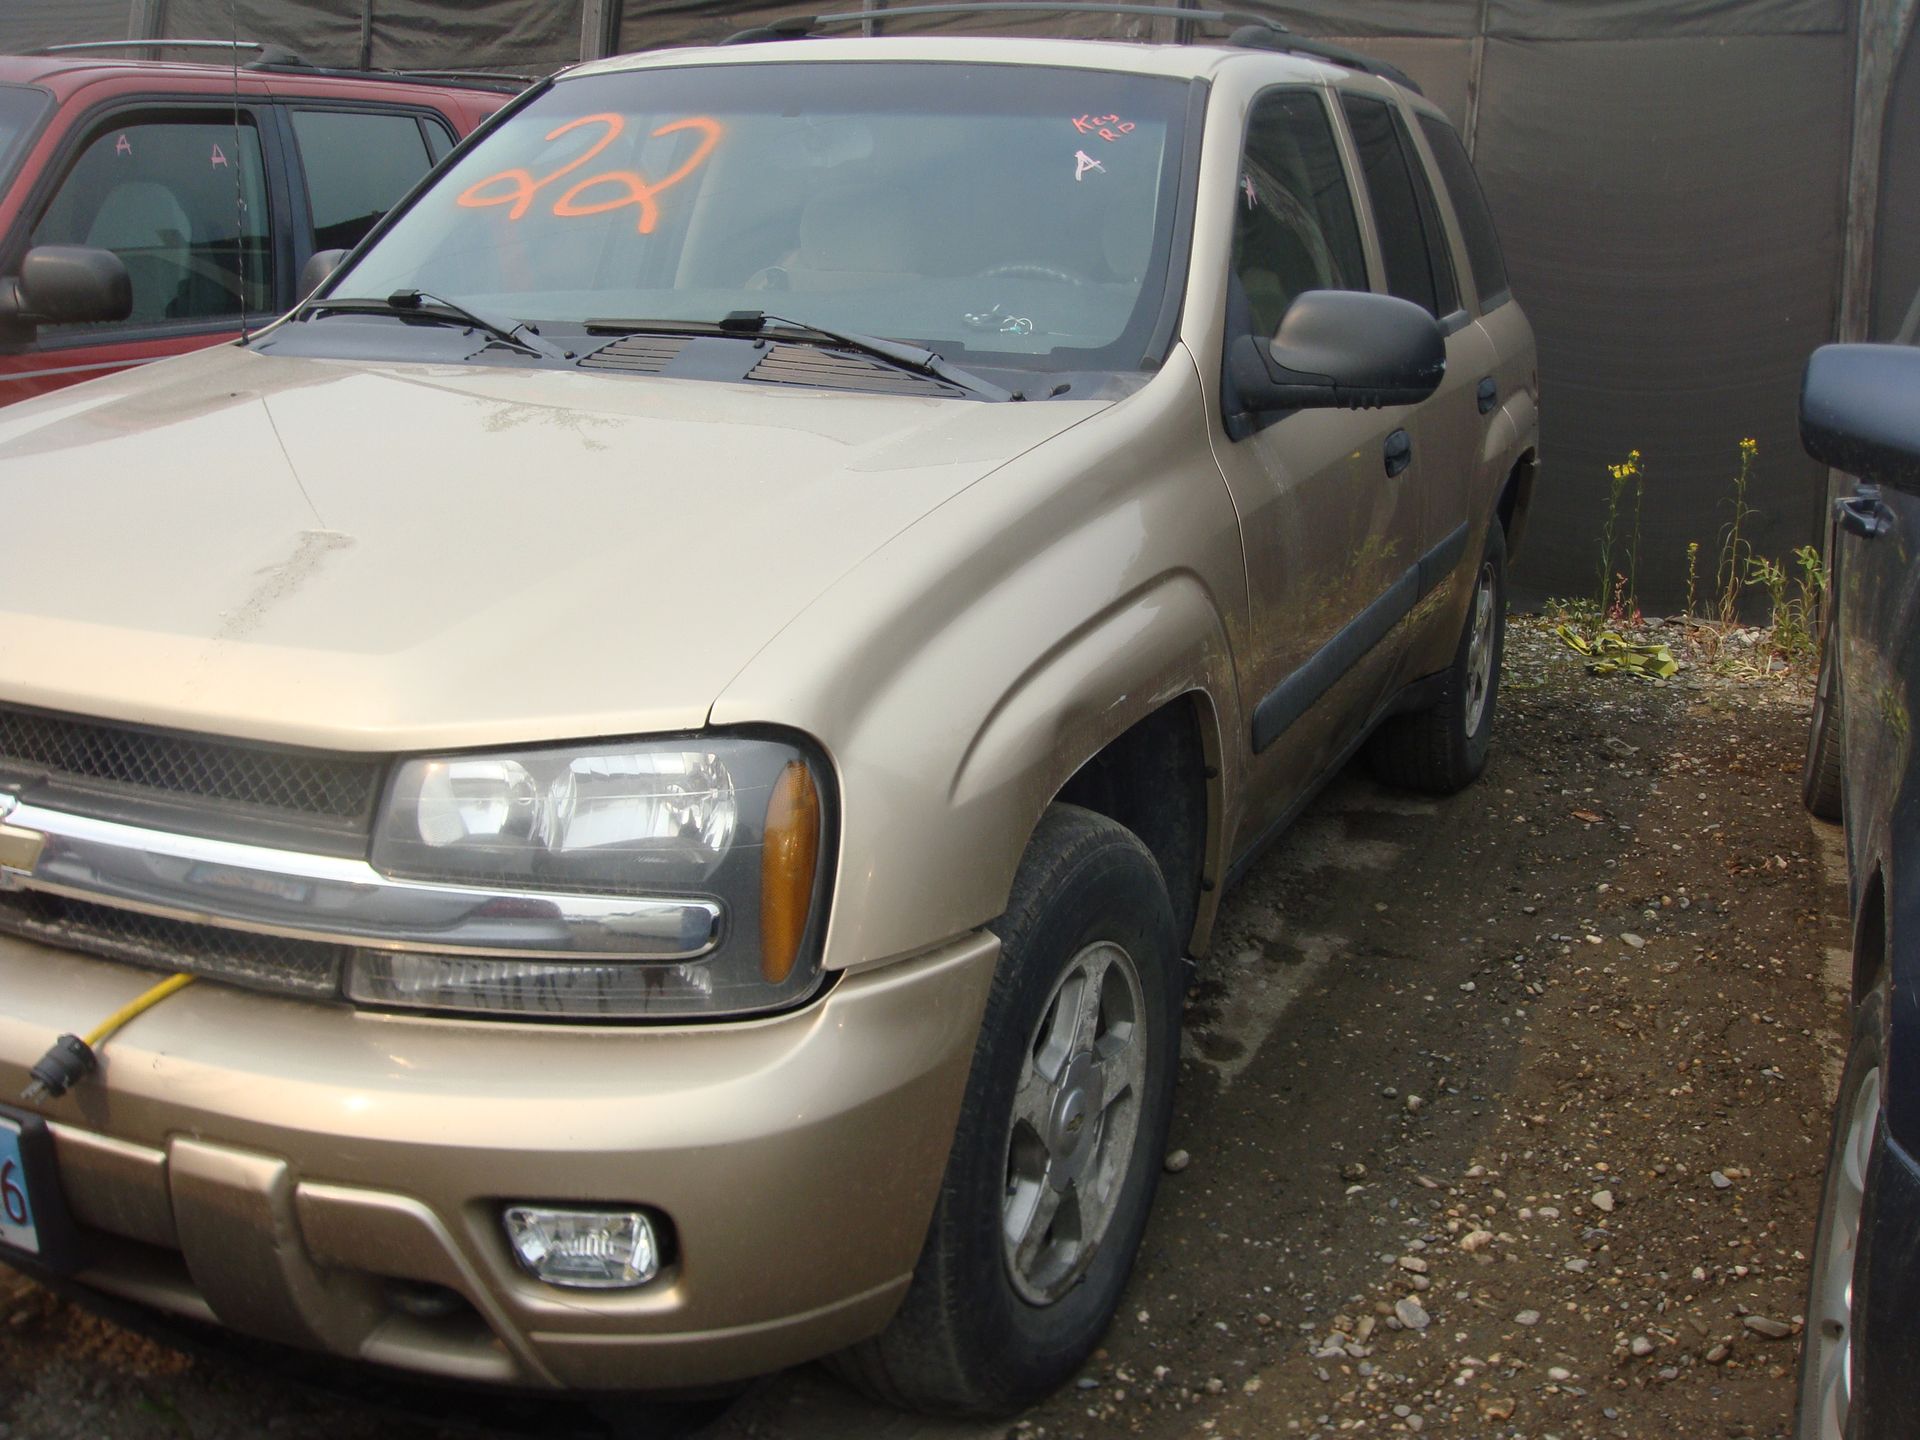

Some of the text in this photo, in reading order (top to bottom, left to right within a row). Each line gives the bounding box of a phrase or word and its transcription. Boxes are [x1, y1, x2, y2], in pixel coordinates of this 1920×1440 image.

[116, 135, 132, 156] A
[211, 144, 228, 169] A
[1075, 150, 1107, 181] A
[1, 1159, 28, 1226] 6
